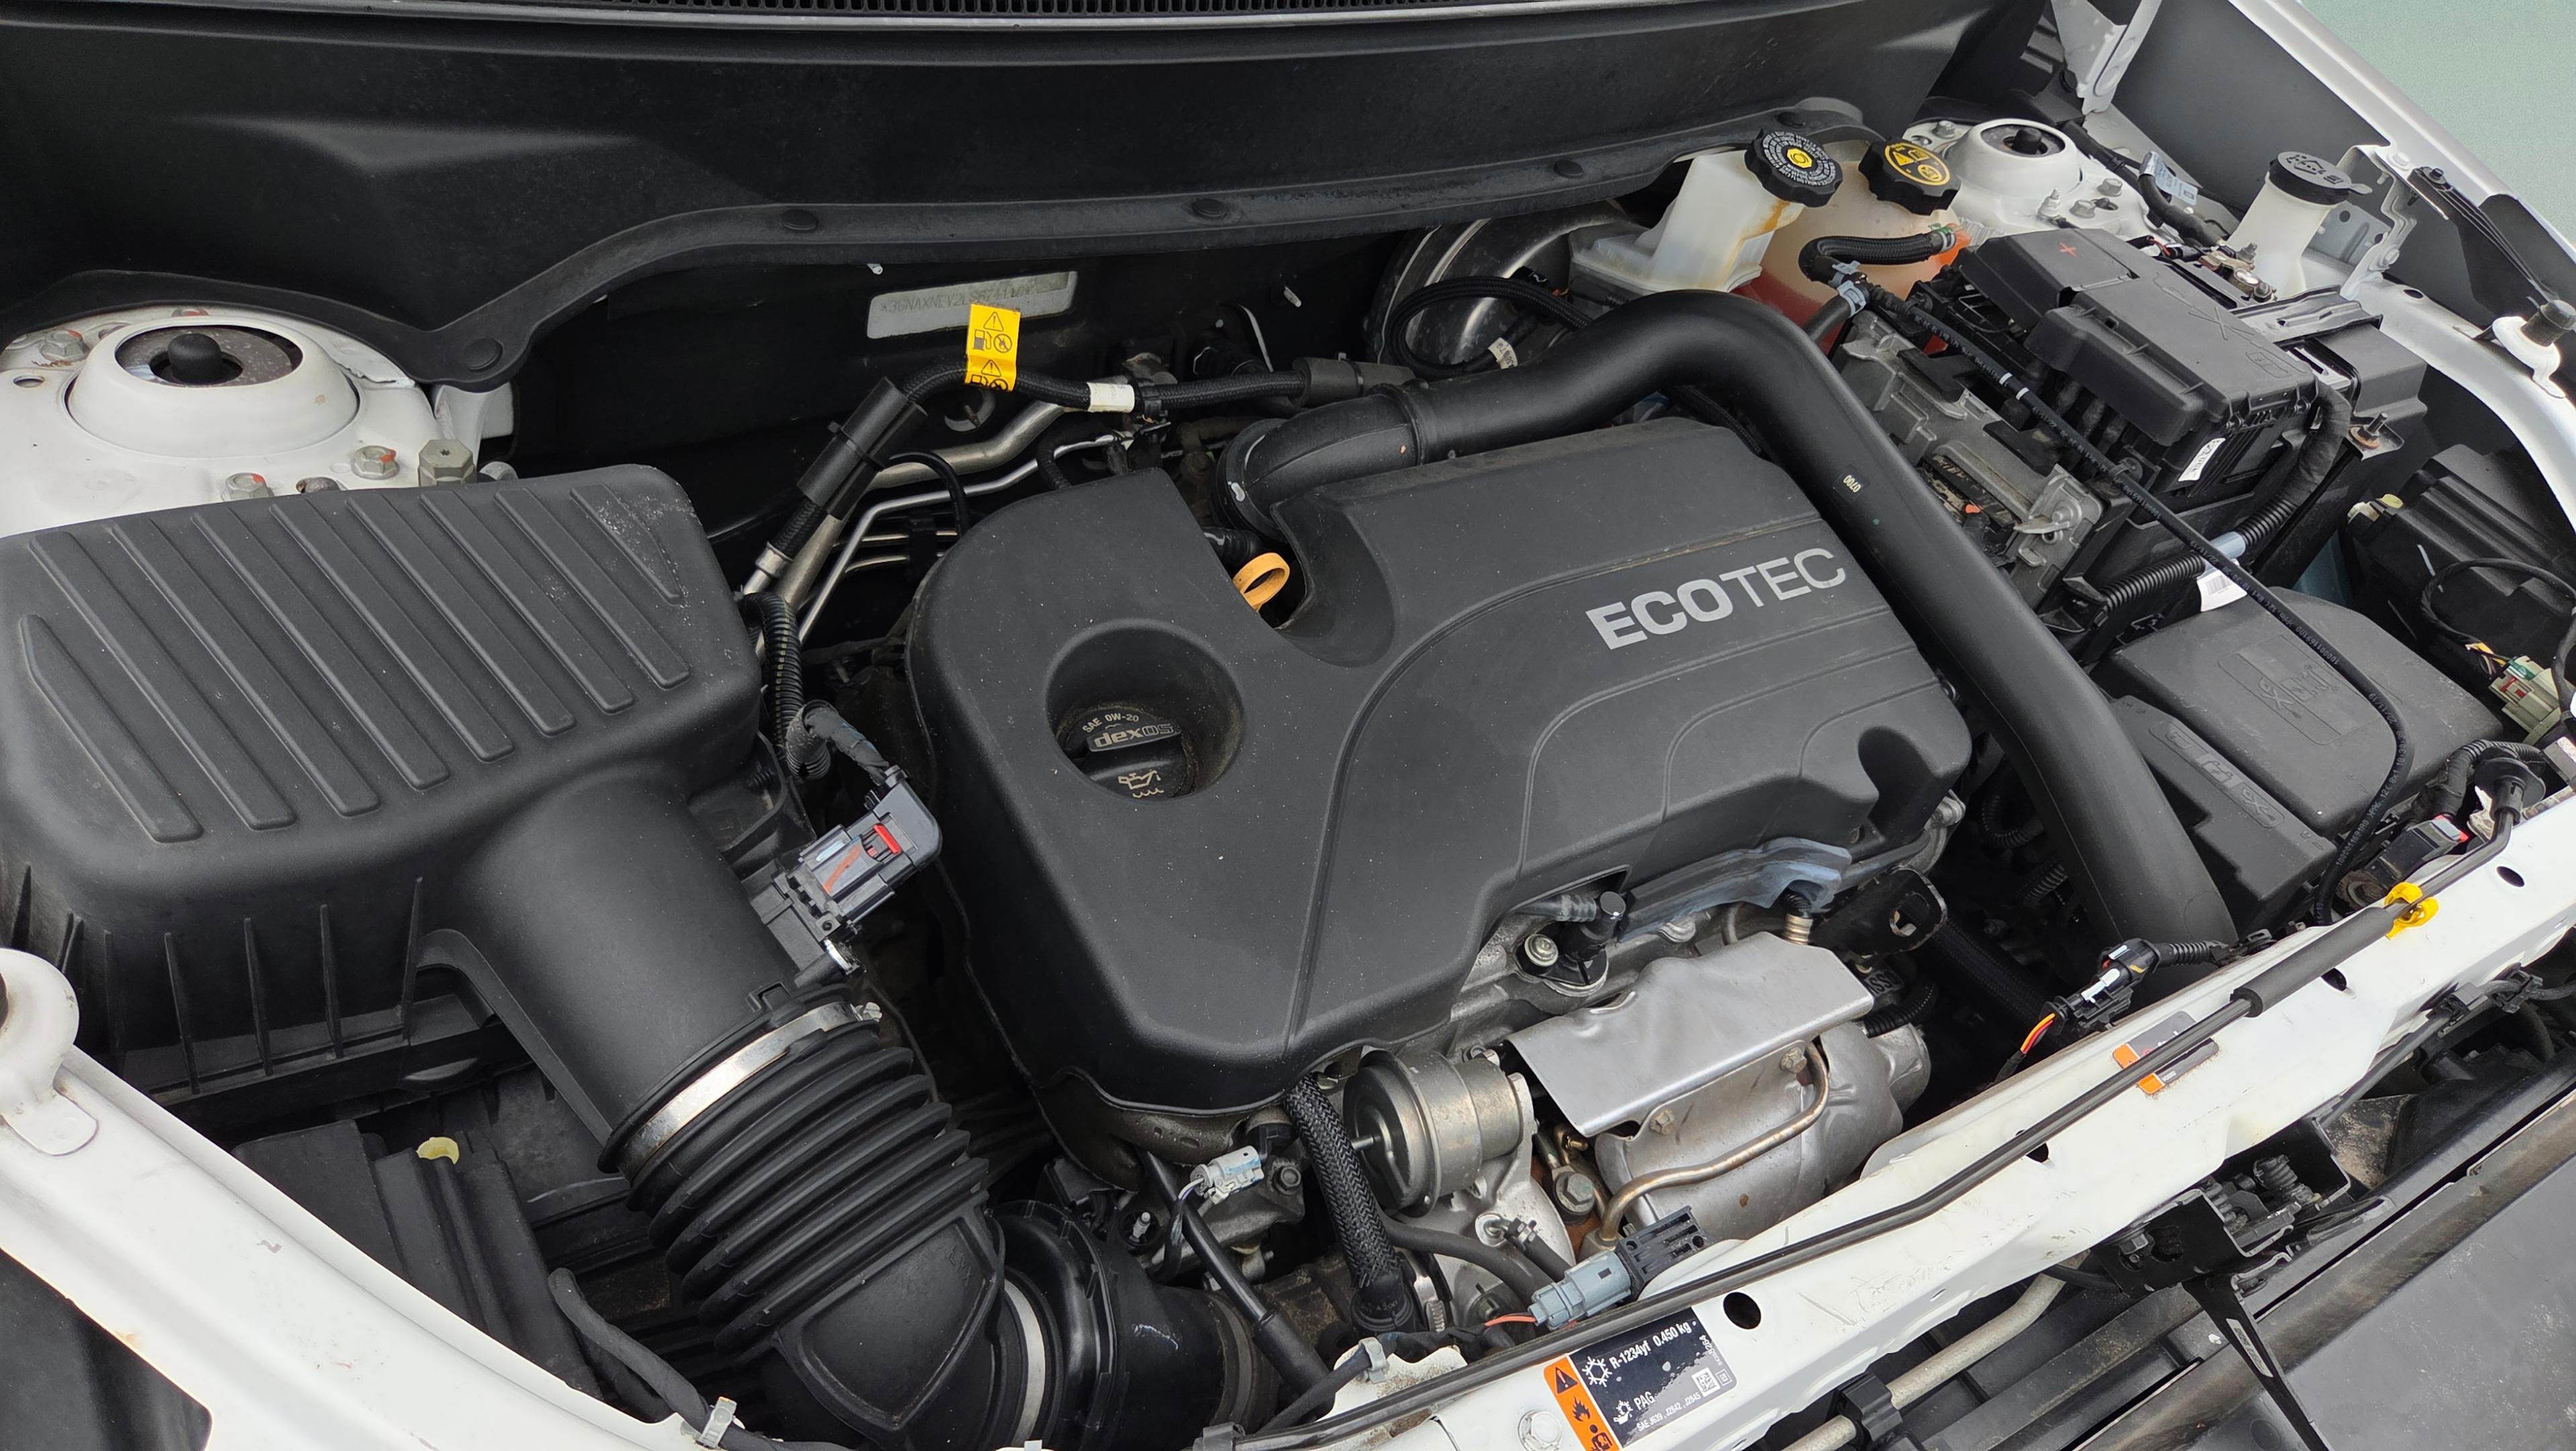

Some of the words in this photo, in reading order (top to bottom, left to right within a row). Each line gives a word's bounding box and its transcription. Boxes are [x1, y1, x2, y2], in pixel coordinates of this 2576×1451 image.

[1585, 547, 1847, 650] ECOTEC
[1081, 717, 1102, 734] SAE
[1105, 713, 1140, 723] 0W-20
[1093, 722, 1175, 748] dexos
[1608, 1339, 1652, 1370] R-1234yf
[1653, 1326, 1679, 1348] 0.450
[1675, 1321, 1692, 1335] kg
[1633, 1391, 1656, 1411] PAG
[1636, 1419, 1650, 1432] SAE
